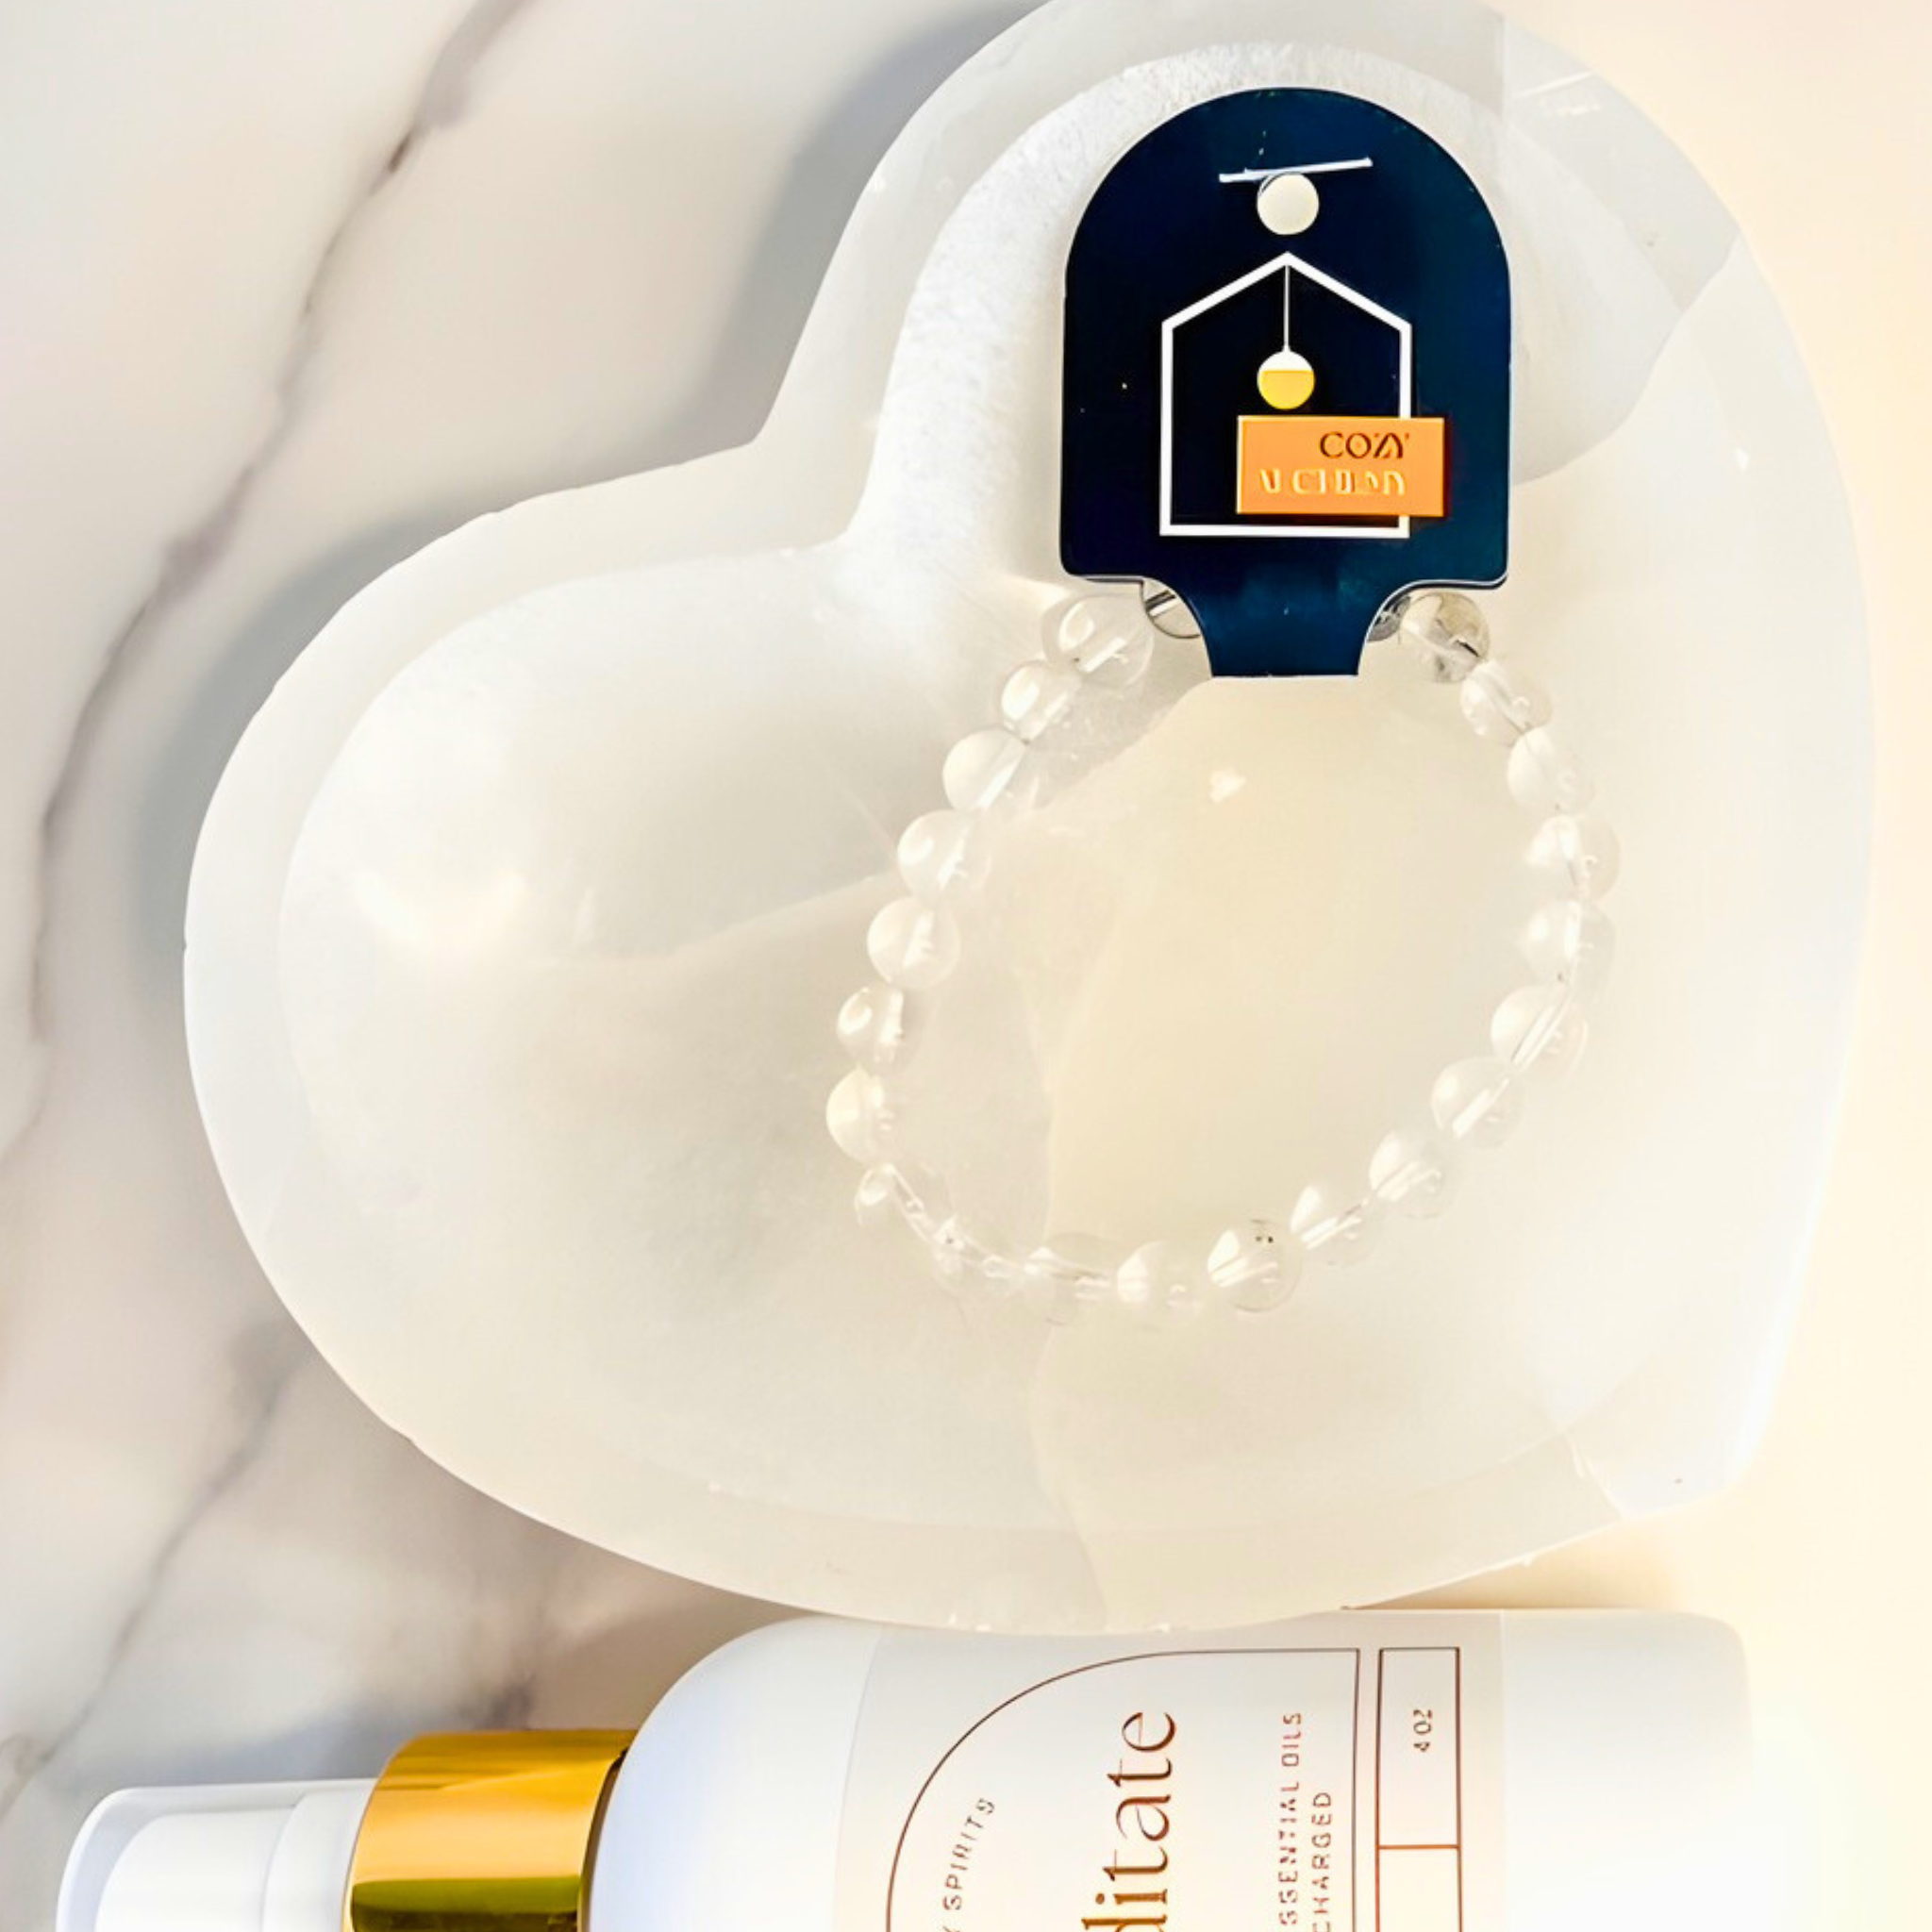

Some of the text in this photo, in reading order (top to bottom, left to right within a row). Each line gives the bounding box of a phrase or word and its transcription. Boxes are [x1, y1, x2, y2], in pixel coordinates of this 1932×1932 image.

[1280, 1711, 1302, 1767] OILS
[1413, 1742, 1430, 1753] 4
[942, 1797, 995, 1911] SPIRITS
[1310, 1792, 1332, 1932] CHARGED
